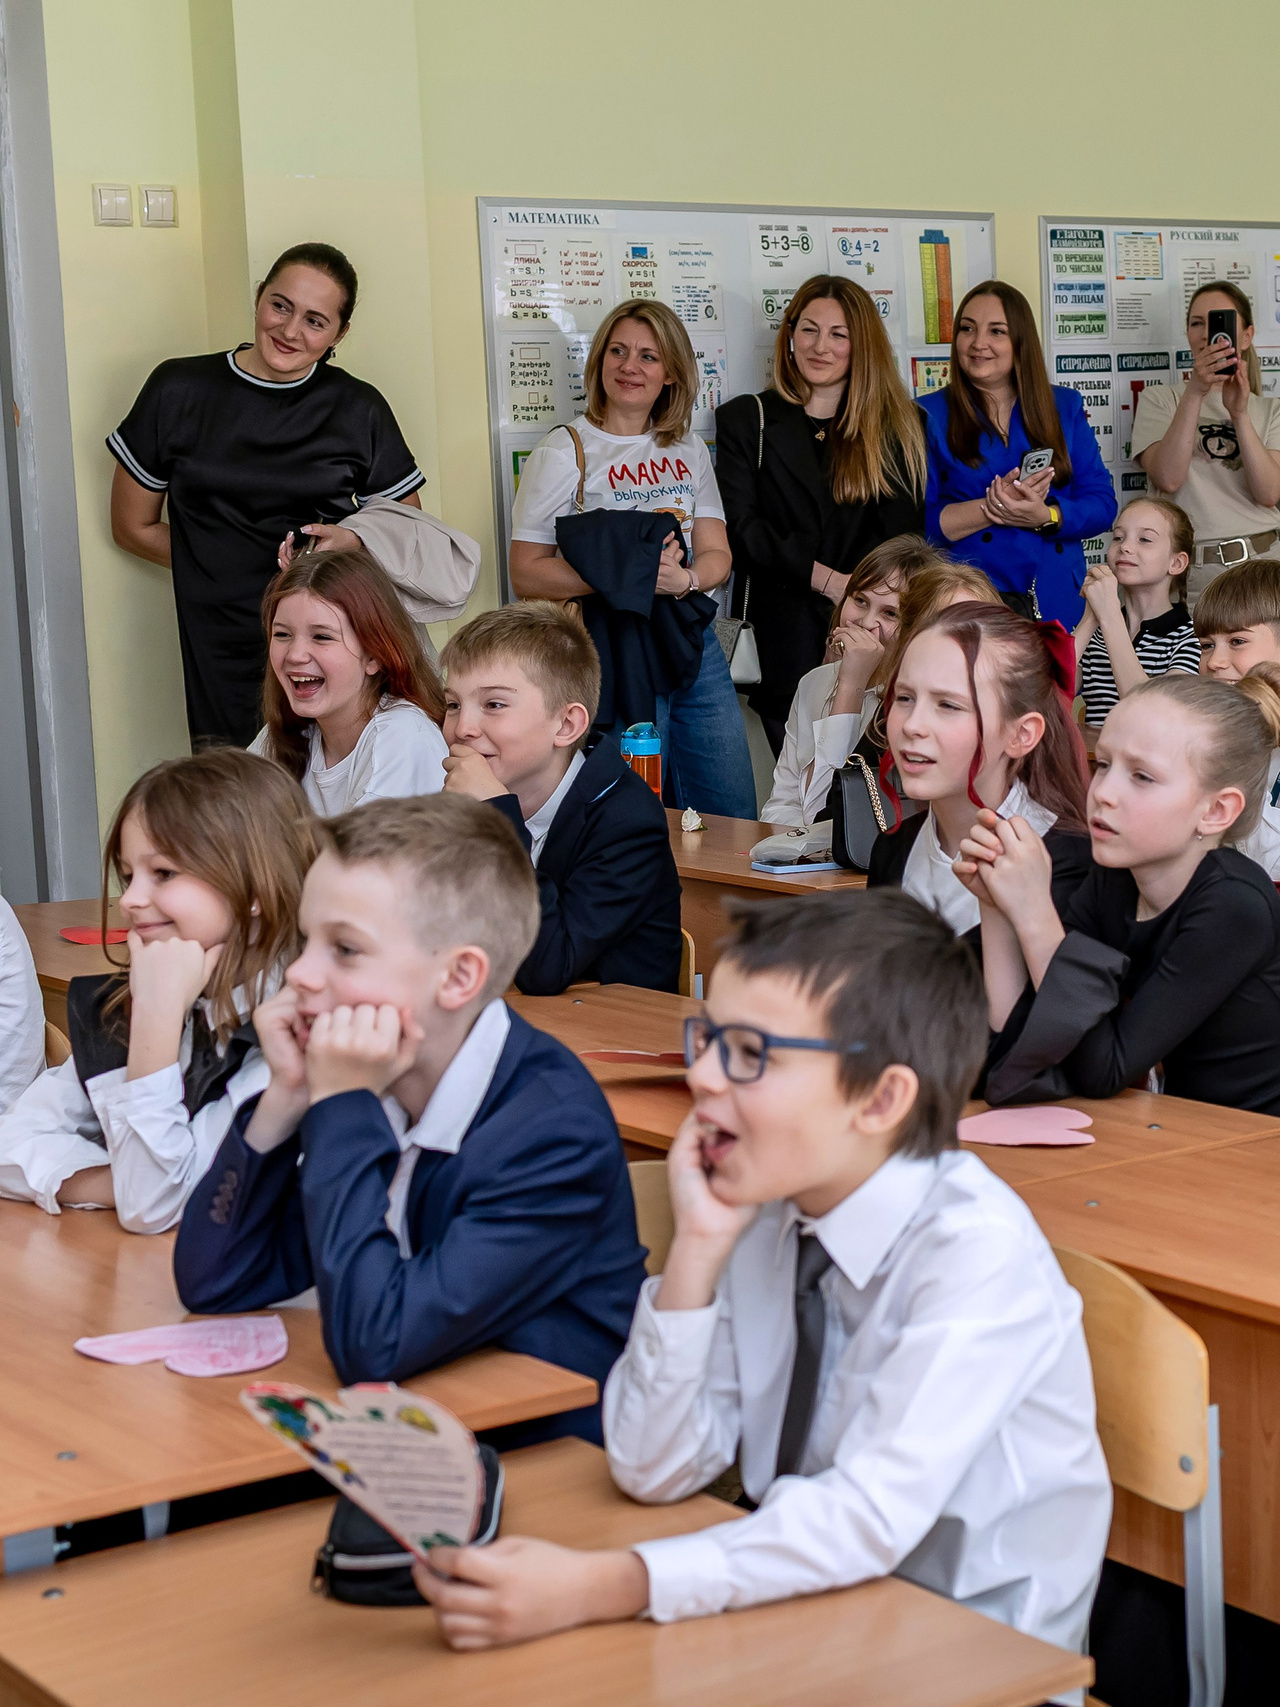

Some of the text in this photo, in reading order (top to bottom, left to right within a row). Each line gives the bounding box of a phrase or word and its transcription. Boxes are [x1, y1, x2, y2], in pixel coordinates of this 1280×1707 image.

[508, 212, 600, 225] МАТЕМАТИКА
[1170, 229, 1240, 242] РУССКИЙ ЯЗЫК
[1053, 254, 1104, 262] ПО ВРЕМЕНАМ
[1056, 265, 1102, 273] ПО ЧИСЛАМ
[1055, 295, 1104, 304] ПО ЛИЦАМ
[1058, 324, 1104, 334] ПО РОДАМ
[1073, 379, 1111, 390] остальные
[1082, 395, 1109, 407] голы
[607, 456, 692, 490] МАМА
